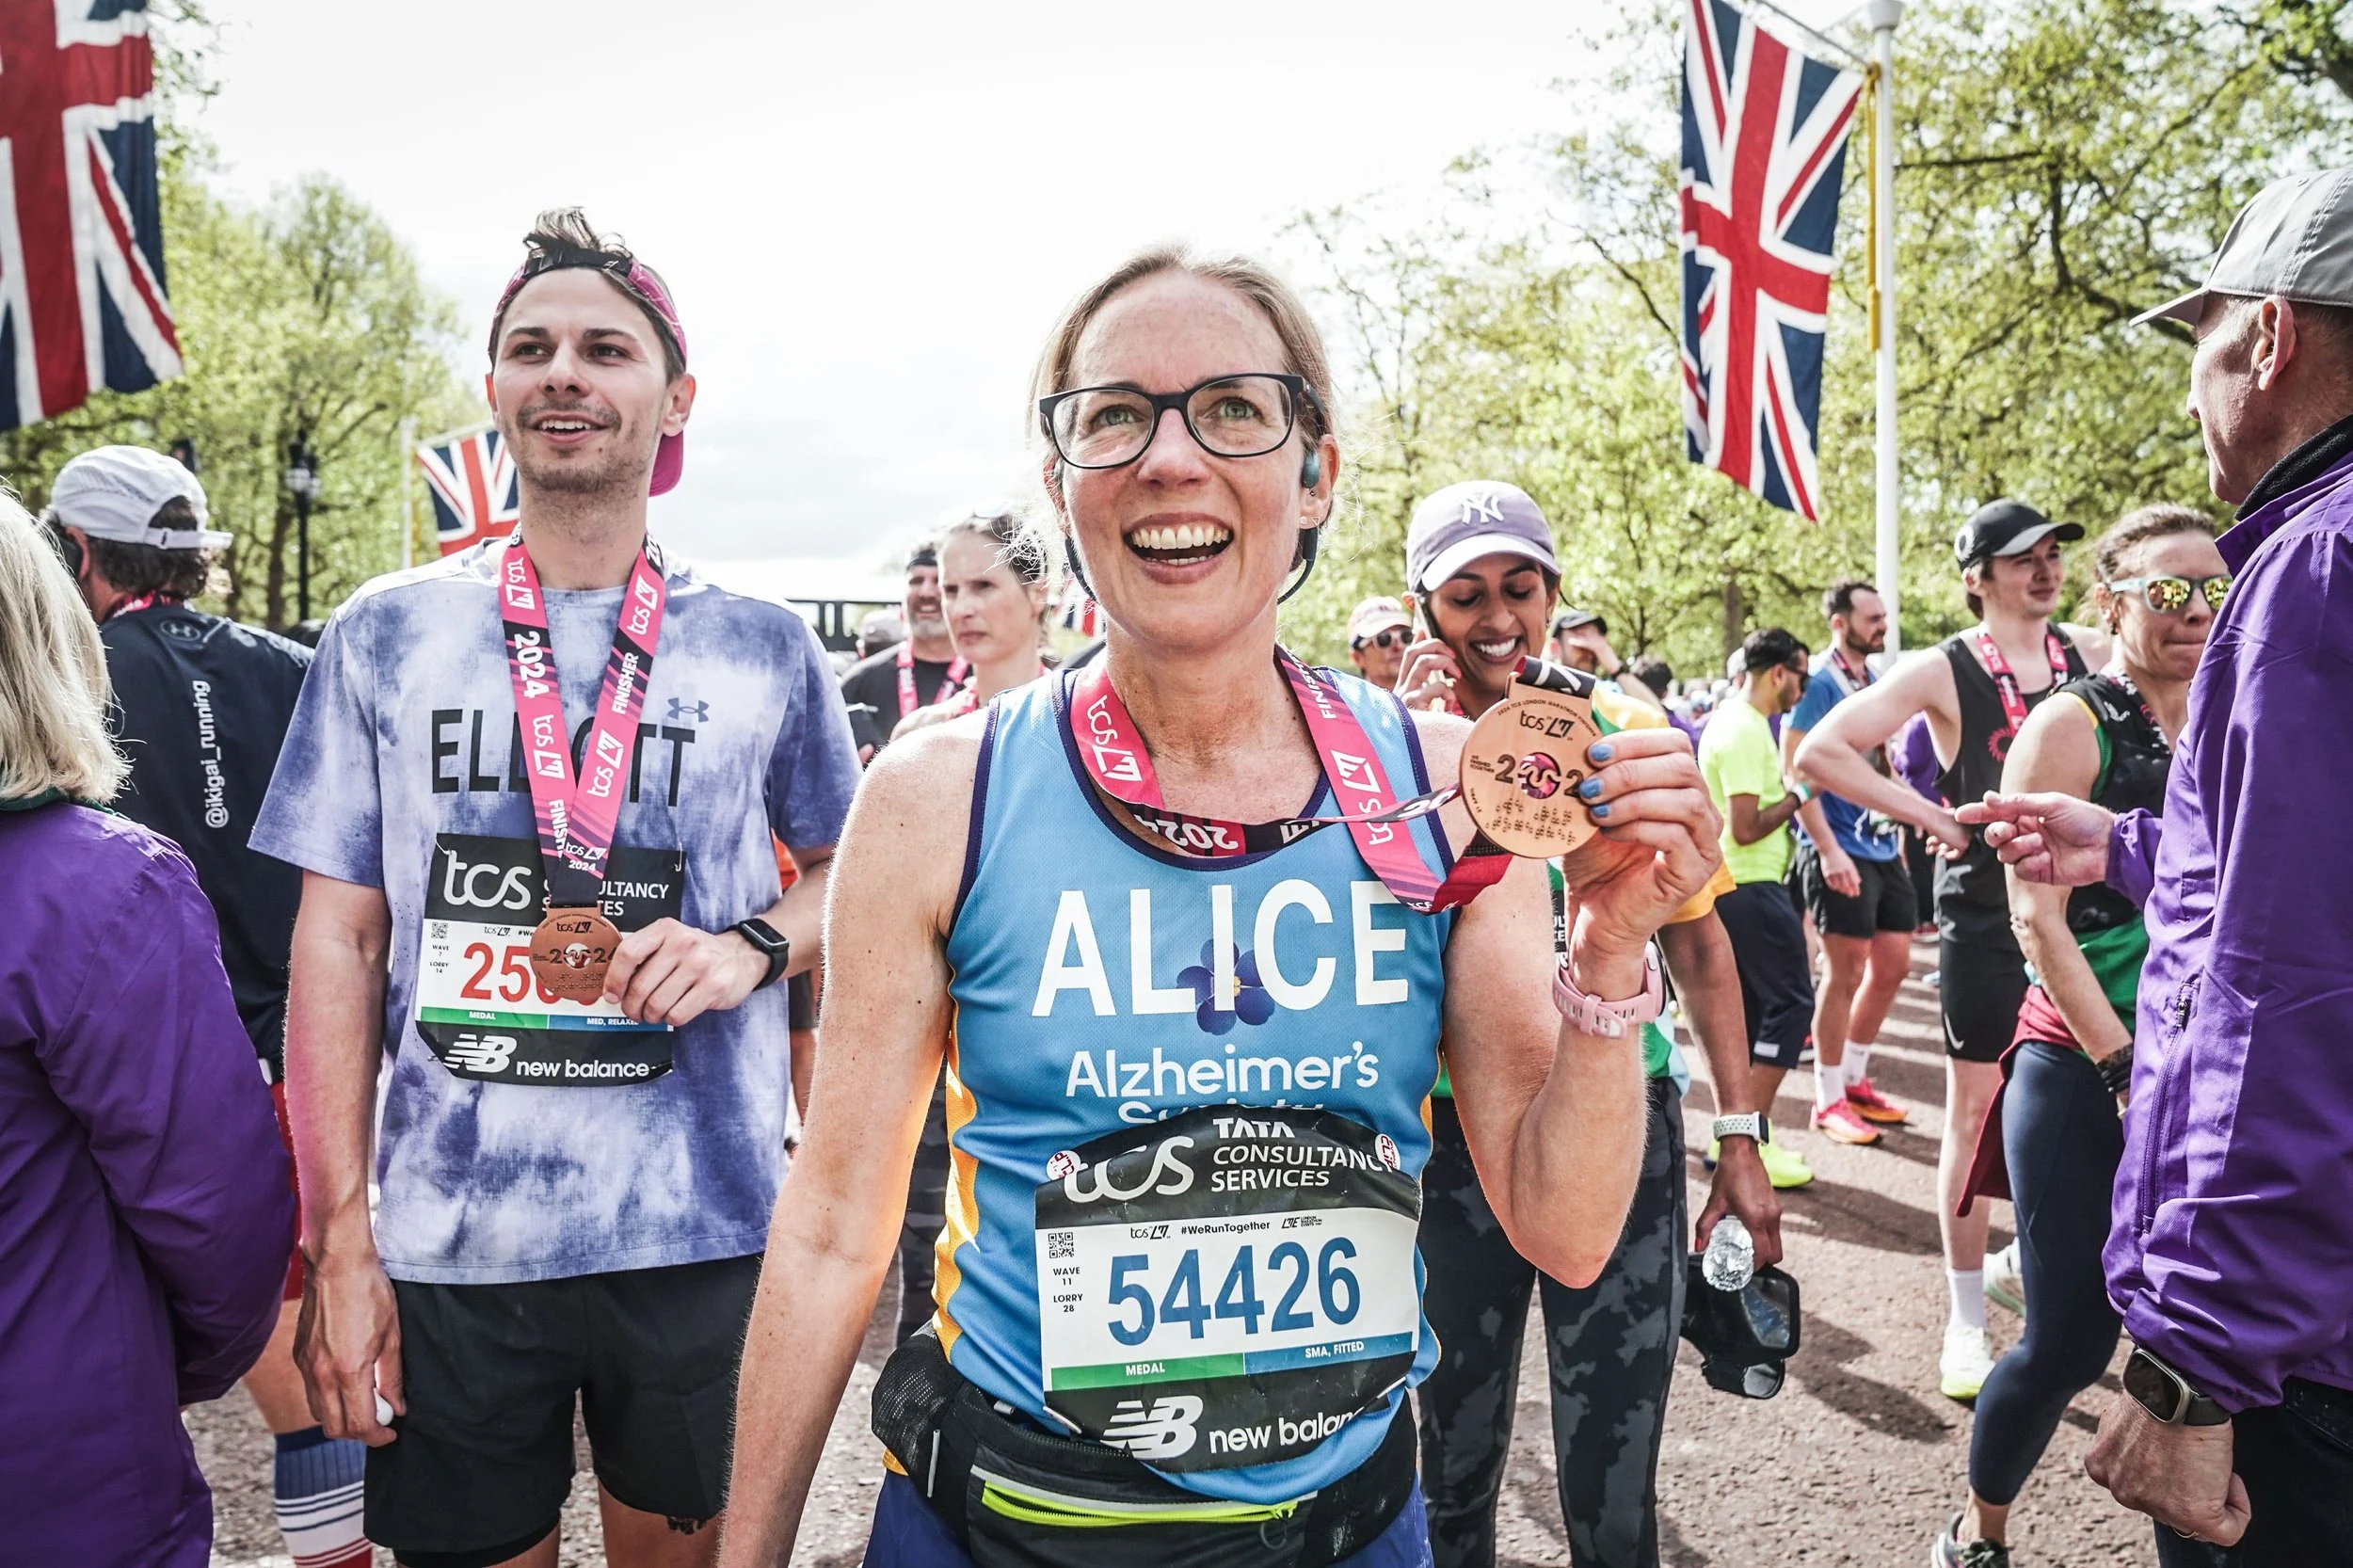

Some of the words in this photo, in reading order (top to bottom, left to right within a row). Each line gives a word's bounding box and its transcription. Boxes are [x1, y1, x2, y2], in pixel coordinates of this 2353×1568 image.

[506, 557, 526, 584] tcs
[626, 605, 651, 635] tcs
[513, 630, 551, 698] 2024
[612, 651, 639, 715] FINISHER
[532, 714, 554, 747] tcs
[1087, 695, 1118, 745] tcs
[1520, 710, 1545, 731] tcs
[192, 680, 230, 828] @ikigai_running
[586, 765, 615, 798] tcs
[566, 841, 585, 856] tcs
[568, 859, 597, 872] 2024
[443, 850, 532, 910] tcs
[556, 922, 573, 933] tcs
[1032, 879, 1409, 1017] ALICE
[469, 1011, 496, 1020] MEDAL
[586, 1017, 606, 1026] MED,
[517, 1060, 560, 1077] new
[565, 1059, 650, 1078] balance
[1212, 1117, 1295, 1139] TATA
[1211, 1168, 1330, 1192] SERVICES
[1130, 1226, 1149, 1239] tcs
[1180, 1222, 1271, 1236] #WeRunTogether
[1052, 1266, 1080, 1276] WAVE
[1063, 1277, 1072, 1286] 11
[1052, 1293, 1083, 1304] LORRY
[1107, 1236, 1361, 1347] 54426
[1063, 1304, 1075, 1313] 28
[1305, 1346, 1331, 1359] SMA,
[1333, 1341, 1365, 1355] FITTED
[1125, 1362, 1165, 1376] MEDAL
[1209, 1425, 1271, 1454] new
